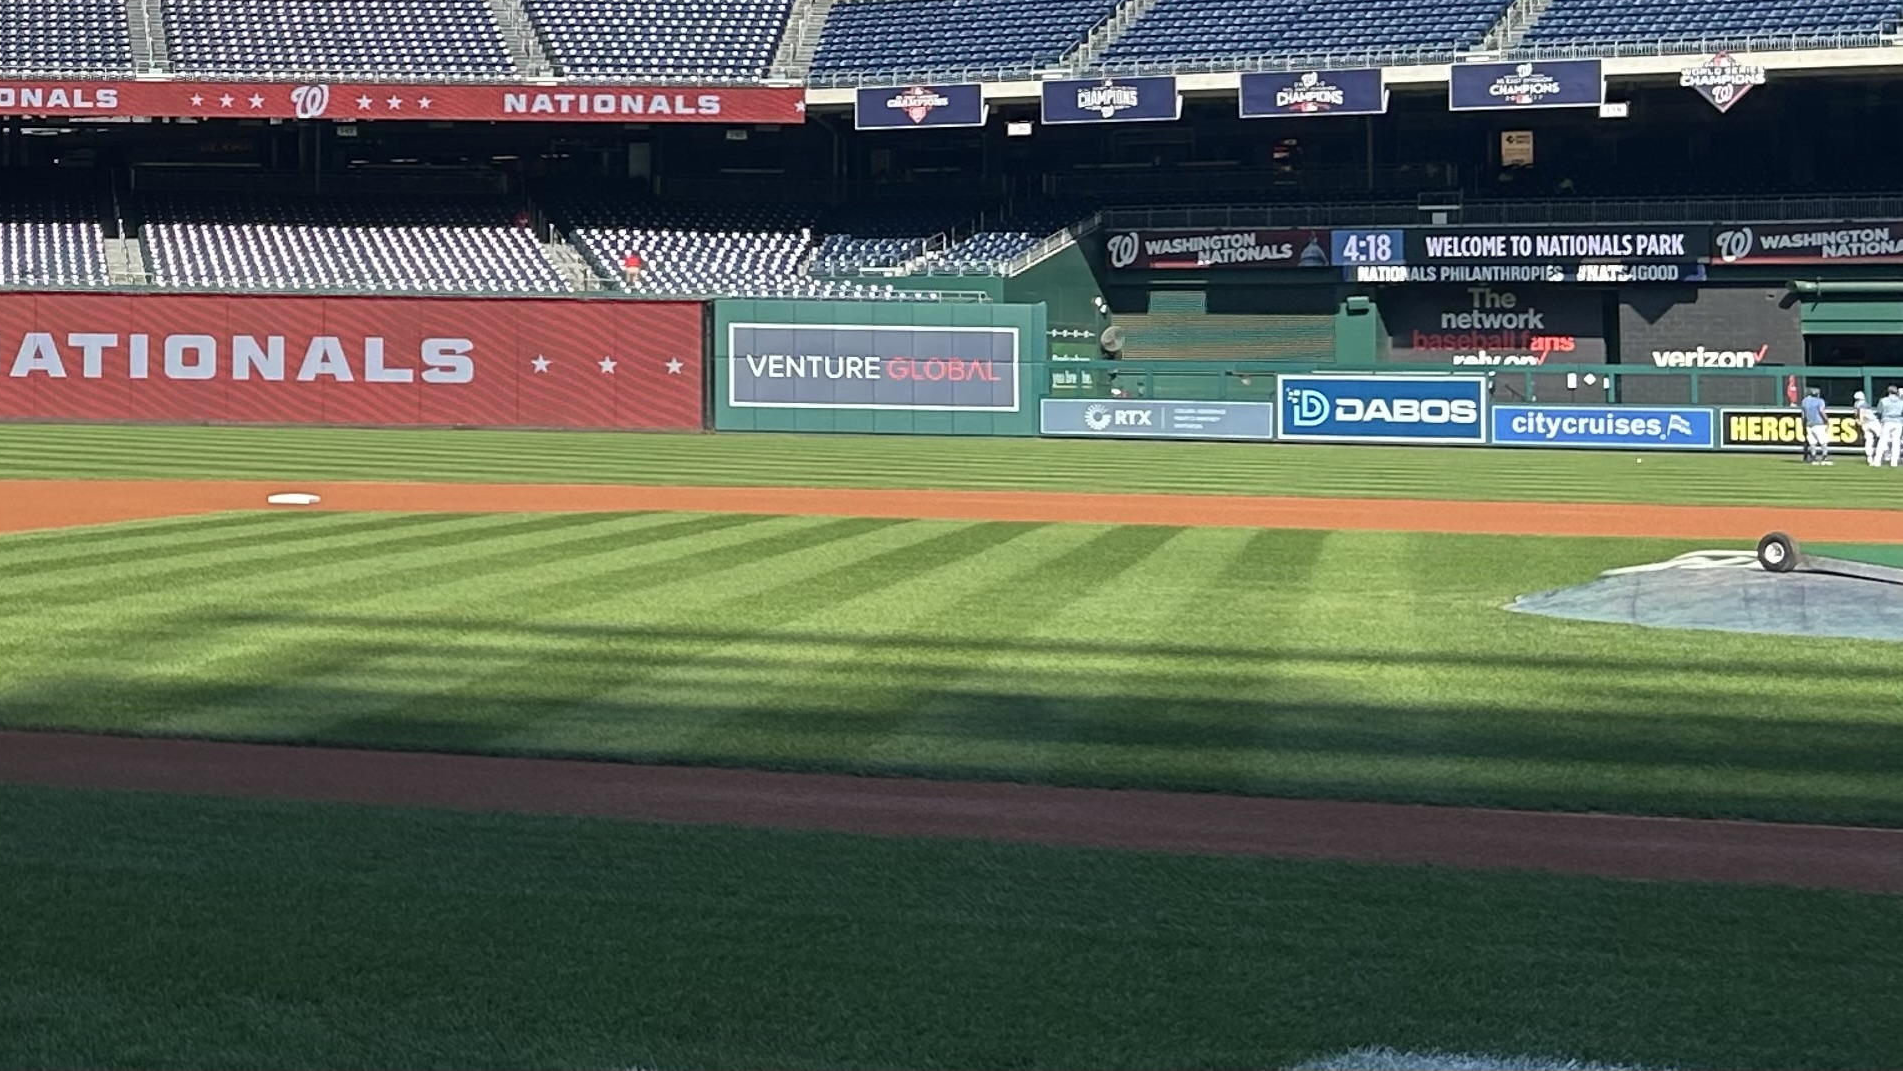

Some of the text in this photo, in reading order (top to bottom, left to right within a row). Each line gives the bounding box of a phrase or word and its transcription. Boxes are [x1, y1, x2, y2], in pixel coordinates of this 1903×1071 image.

[1489, 81, 1561, 96] CHAMPIONS
[1680, 74, 1766, 87] CHAMPIONS
[504, 93, 722, 116] NATIONALS
[1077, 89, 1137, 108] CHAMPIONS
[1277, 90, 1344, 107] CHAMPIONS
[1145, 233, 1256, 256] WASHINGTON
[1343, 234, 1392, 262] 4:18
[1425, 234, 1685, 258] WELCOME TO NATIONALS PARK
[1760, 228, 1890, 250] WASHINGTON
[1197, 242, 1293, 266] NATIONALS
[1357, 265, 1437, 282] NATIONALS
[1440, 265, 1564, 282] PHILANTHROPIES
[1468, 287, 1517, 308] The
[1441, 308, 1545, 329] network
[1413, 330, 1576, 352] baseball fans
[746, 354, 1001, 381] VENTURE GLOBAL
[1652, 347, 1755, 367] verizon
[1115, 410, 1152, 425] RTX
[1335, 398, 1477, 423] DABOS
[1512, 411, 1661, 437] citycruises
[1730, 416, 1859, 444] HERCUES
